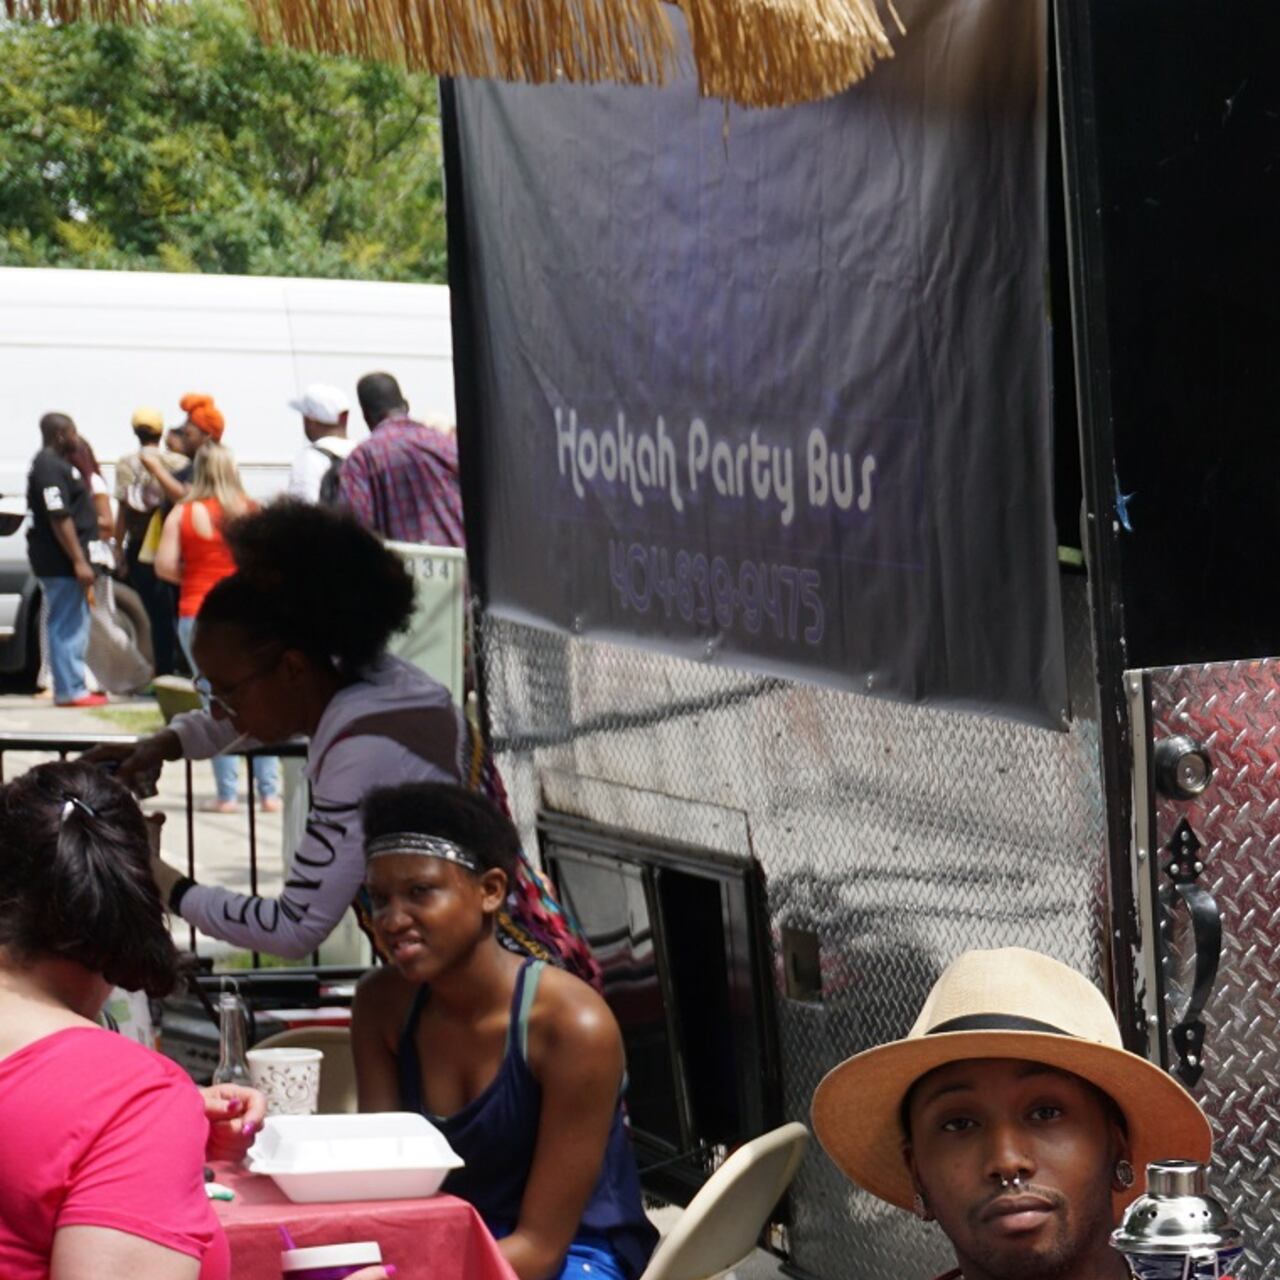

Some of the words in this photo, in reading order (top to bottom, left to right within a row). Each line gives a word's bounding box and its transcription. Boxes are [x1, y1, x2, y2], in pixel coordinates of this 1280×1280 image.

[555, 407, 684, 514] Hookah
[687, 418, 795, 527] Party
[807, 427, 877, 512] Bus
